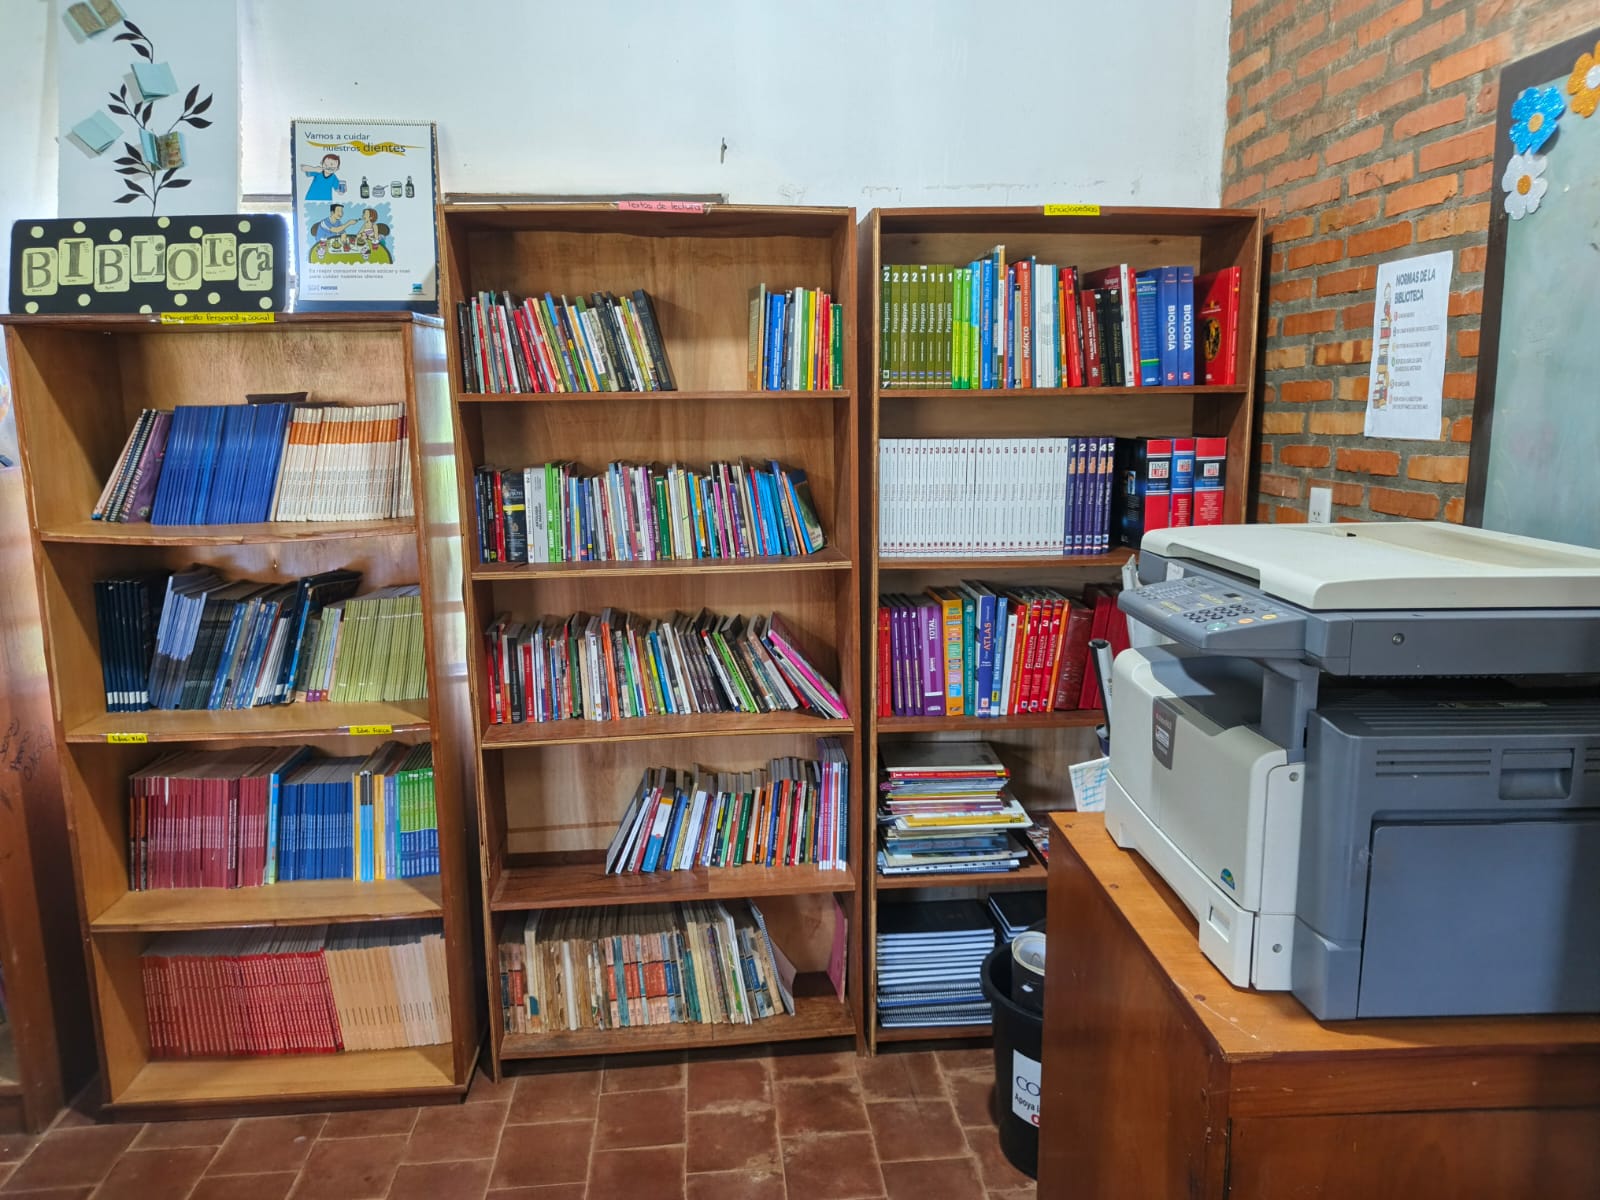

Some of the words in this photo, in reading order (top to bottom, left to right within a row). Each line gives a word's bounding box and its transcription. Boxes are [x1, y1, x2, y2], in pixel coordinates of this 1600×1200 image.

[304, 131, 334, 140] Vamos
[344, 132, 370, 140] cuidar
[364, 142, 406, 153] dientes
[1396, 270, 1420, 288] NORMAS
[1420, 269, 1428, 282] DE
[1428, 268, 1436, 281] LA
[1168, 305, 1177, 351] BIOLOGÍA
[1183, 304, 1192, 350] BIOLOGÍA
[1152, 469, 1167, 477] LIFE
[983, 622, 992, 650] ATLAS
